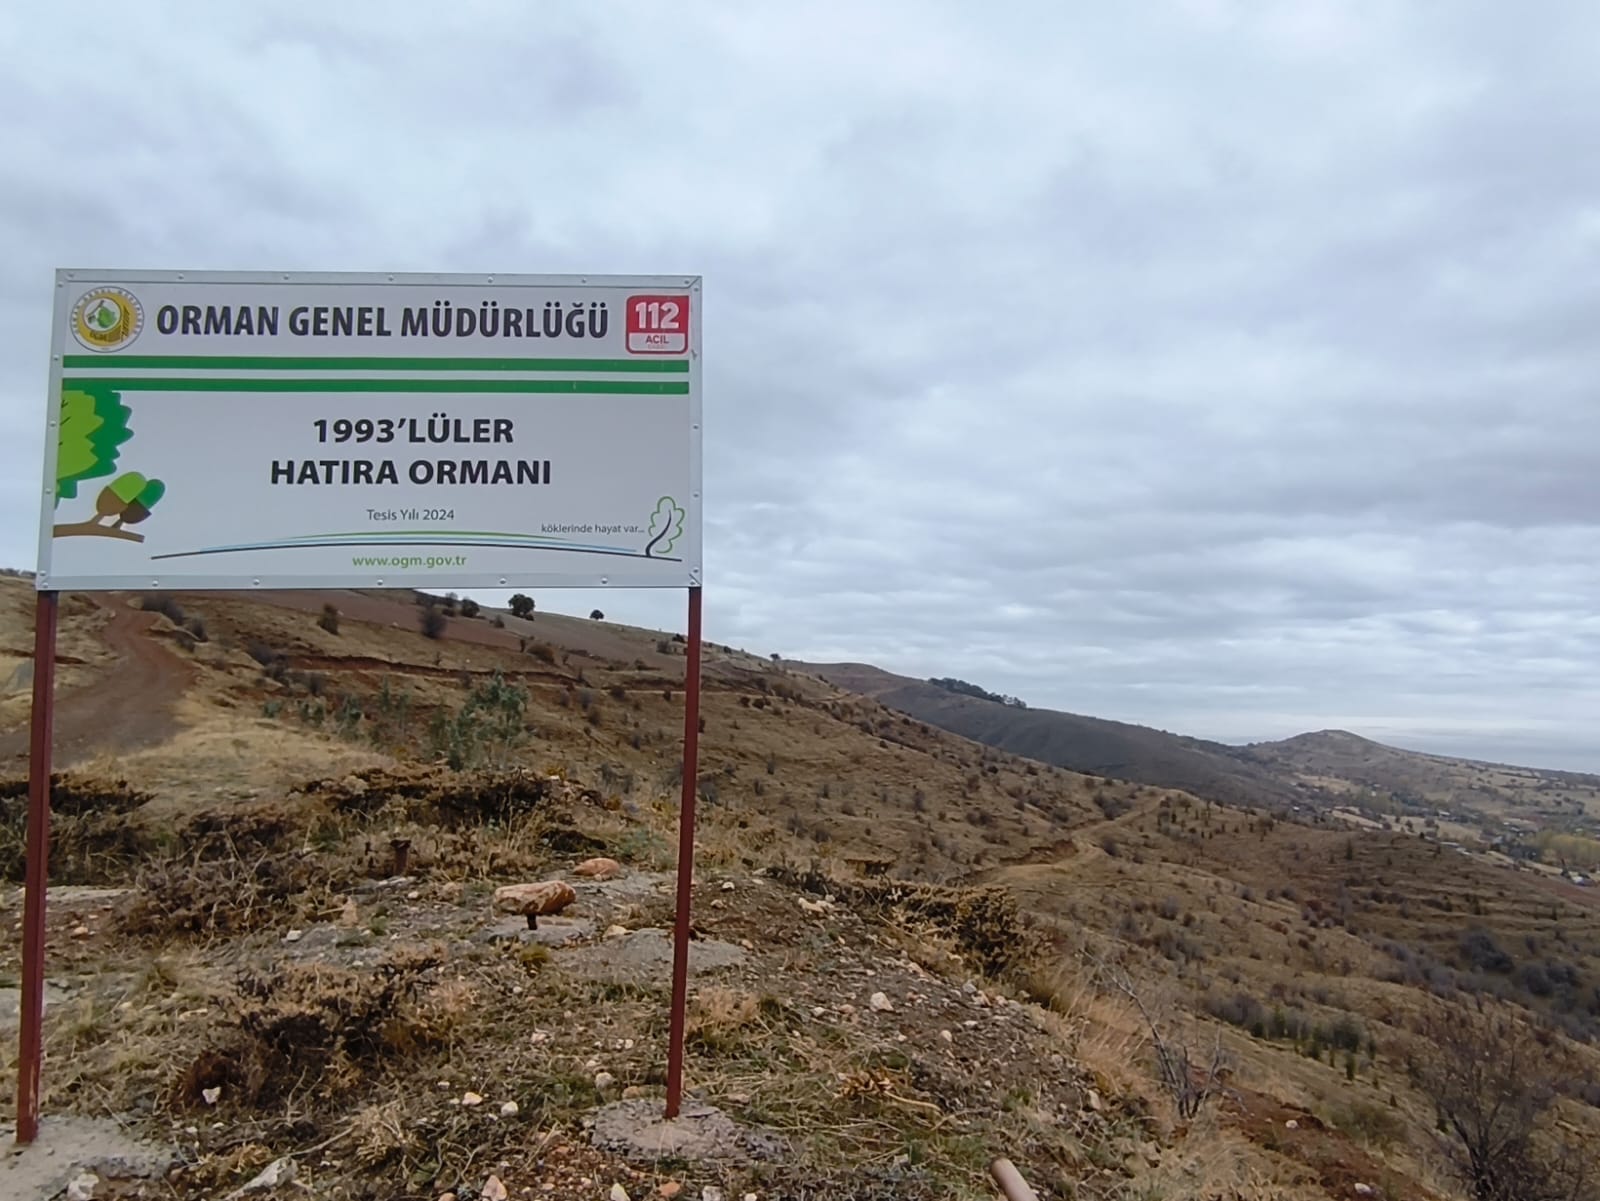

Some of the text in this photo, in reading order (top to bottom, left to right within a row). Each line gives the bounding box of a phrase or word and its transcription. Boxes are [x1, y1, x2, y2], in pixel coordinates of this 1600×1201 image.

[157, 305, 279, 336] ORMAN
[289, 306, 392, 337] GENEL
[401, 300, 608, 338] MÜDÜRLÜĞÜ
[635, 301, 680, 329] 112
[271, 459, 551, 485] HATIRA ORMANI
[367, 508, 455, 521] Tesis Yılı 2024
[541, 524, 593, 533] köklerinde
[595, 524, 621, 535] hayat
[352, 555, 466, 569] www.ogm.gov.tr
